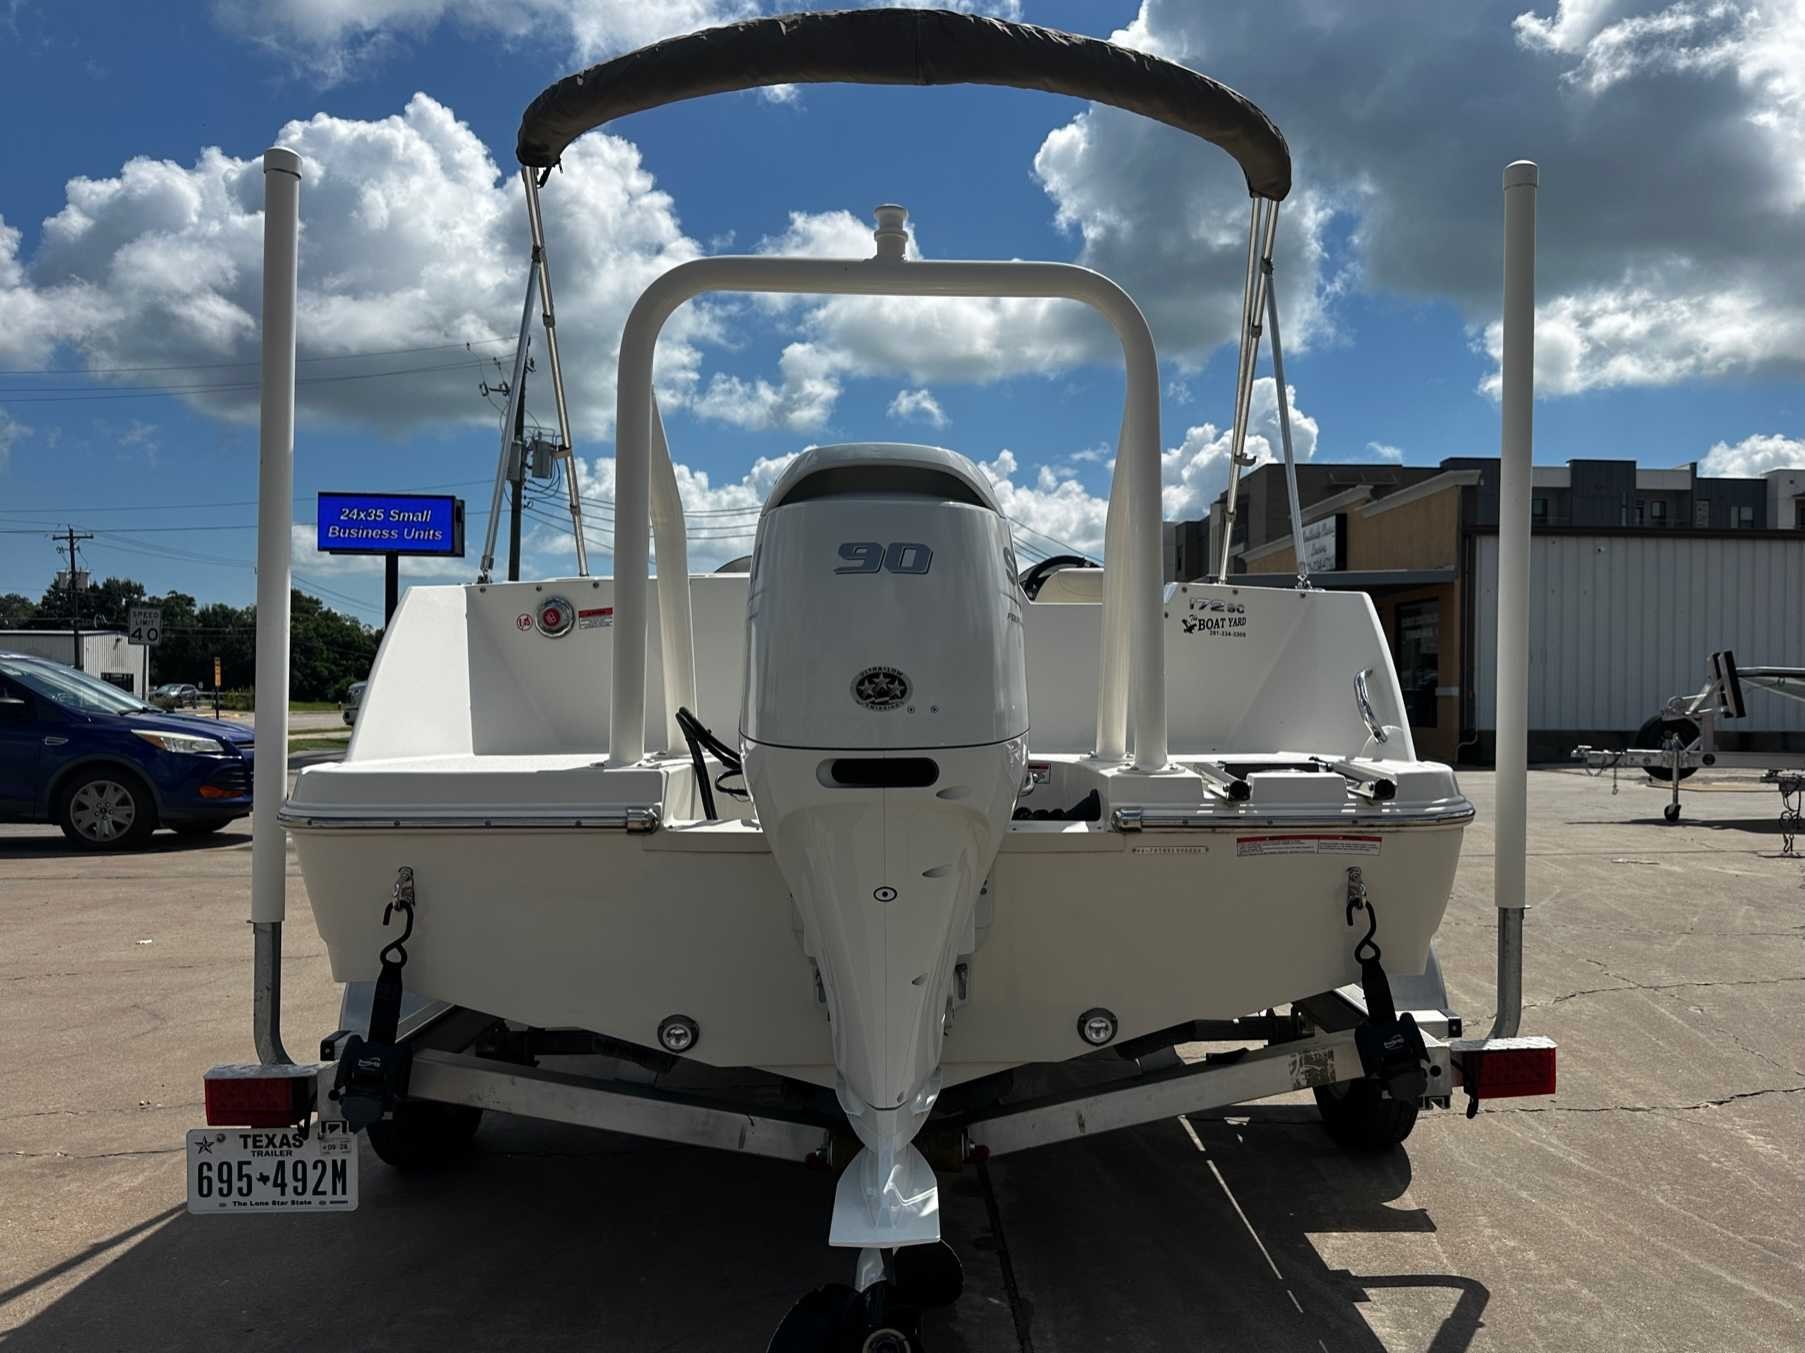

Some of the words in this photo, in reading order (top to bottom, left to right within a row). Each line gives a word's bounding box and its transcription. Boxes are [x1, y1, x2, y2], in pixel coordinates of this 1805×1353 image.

[339, 507, 385, 521] 24x35
[389, 509, 432, 522] Small
[328, 525, 398, 539] Business
[403, 527, 443, 541] Units
[833, 541, 934, 575] 90
[132, 611, 159, 619] SPEED
[1198, 617, 1227, 631] BOAT
[1228, 616, 1247, 628] YARD
[131, 627, 159, 641] 40
[239, 1133, 304, 1149] TEXAS
[251, 1149, 293, 1157] TRAILER
[197, 1160, 253, 1198] 695
[272, 1158, 347, 1197] 492M
